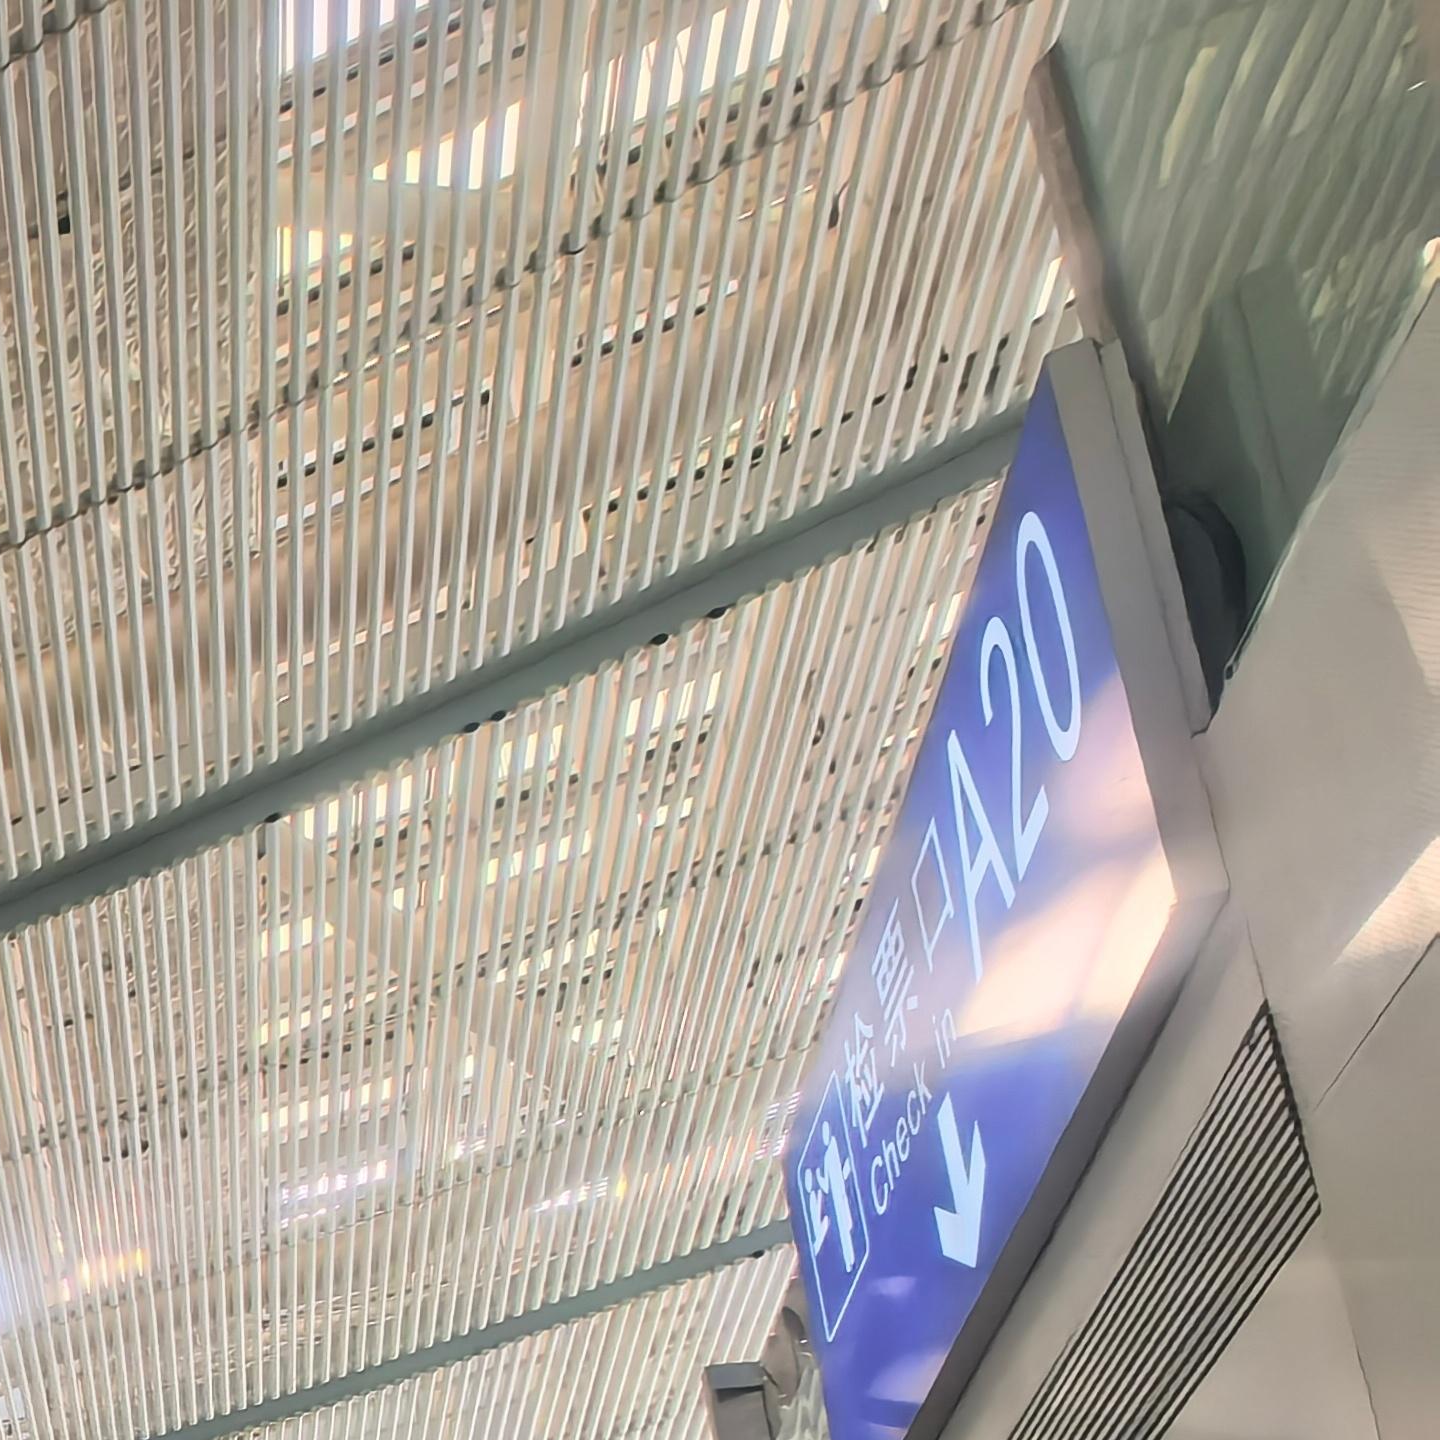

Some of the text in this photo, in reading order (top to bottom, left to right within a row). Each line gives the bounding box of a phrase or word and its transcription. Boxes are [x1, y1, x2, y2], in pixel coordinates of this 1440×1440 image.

[844, 508, 1082, 1148] 检票口 A20
[870, 1007, 958, 1216] Check in
